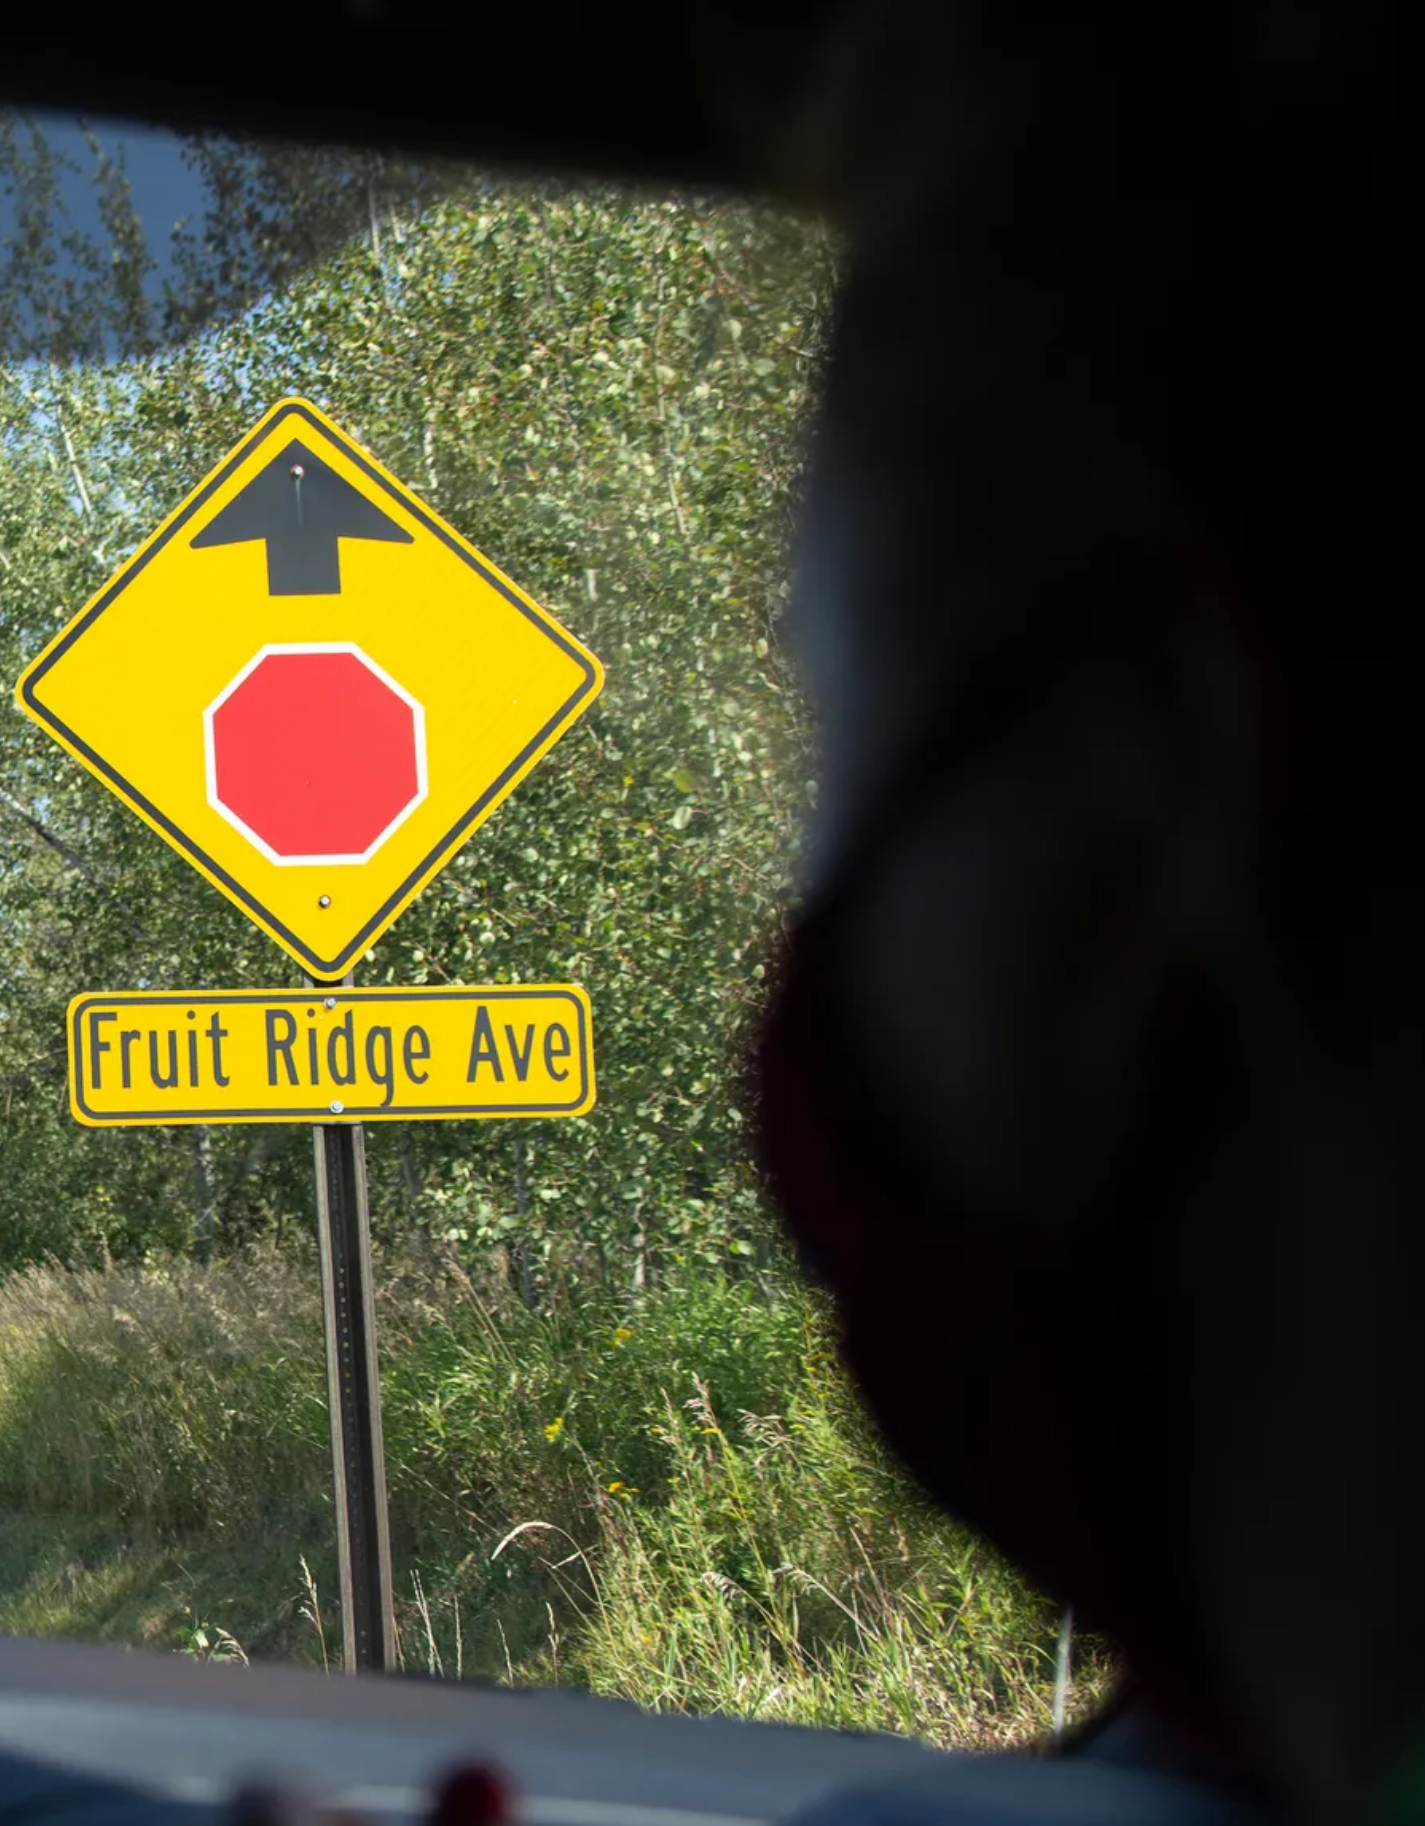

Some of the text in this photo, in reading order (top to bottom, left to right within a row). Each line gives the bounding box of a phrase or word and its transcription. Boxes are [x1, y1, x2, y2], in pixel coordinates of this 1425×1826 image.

[89, 1005, 572, 1108] Fruit Ridge Ave
